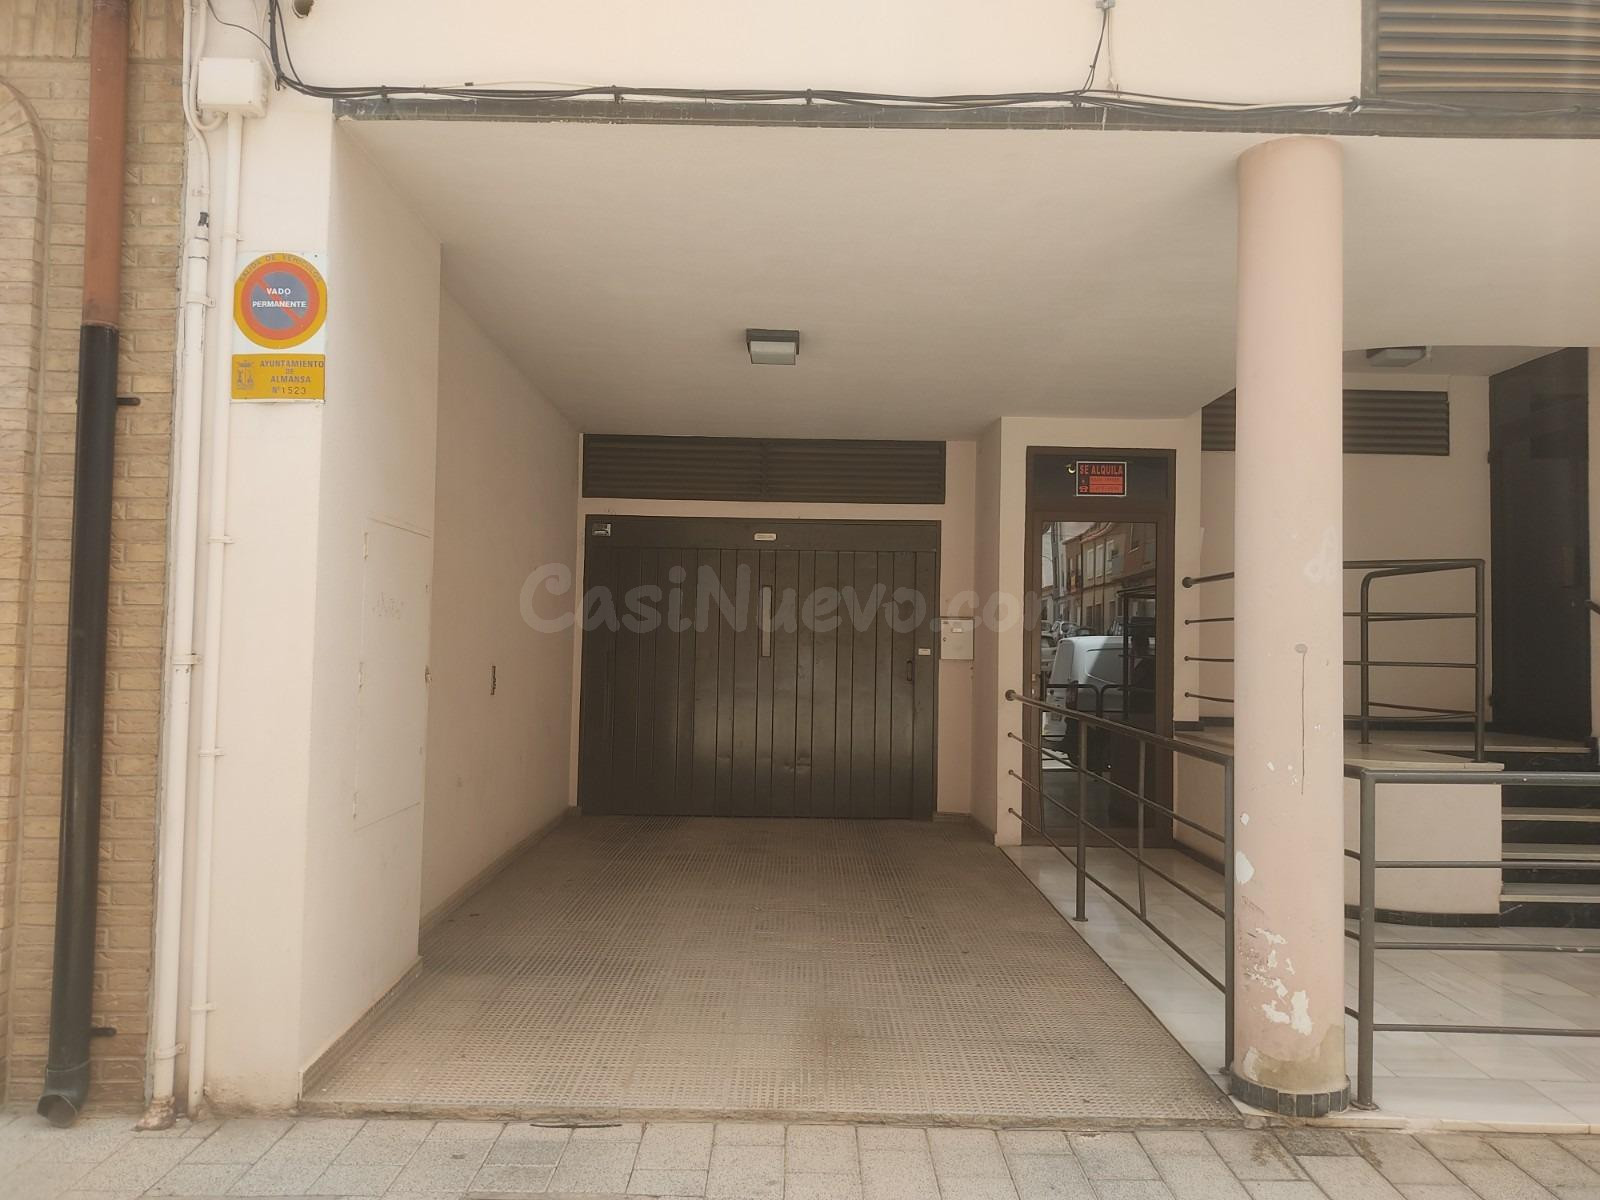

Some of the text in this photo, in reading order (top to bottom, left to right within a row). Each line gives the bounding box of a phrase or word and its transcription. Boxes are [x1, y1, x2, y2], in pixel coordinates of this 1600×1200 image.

[266, 287, 291, 295] VADO
[252, 300, 307, 308] PERMANENTE
[260, 360, 324, 368] AYUNTAMIENTO
[270, 375, 311, 384] ALMANSA
[282, 386, 306, 394] 1523
[1079, 464, 1122, 475] SE ALQUILA
